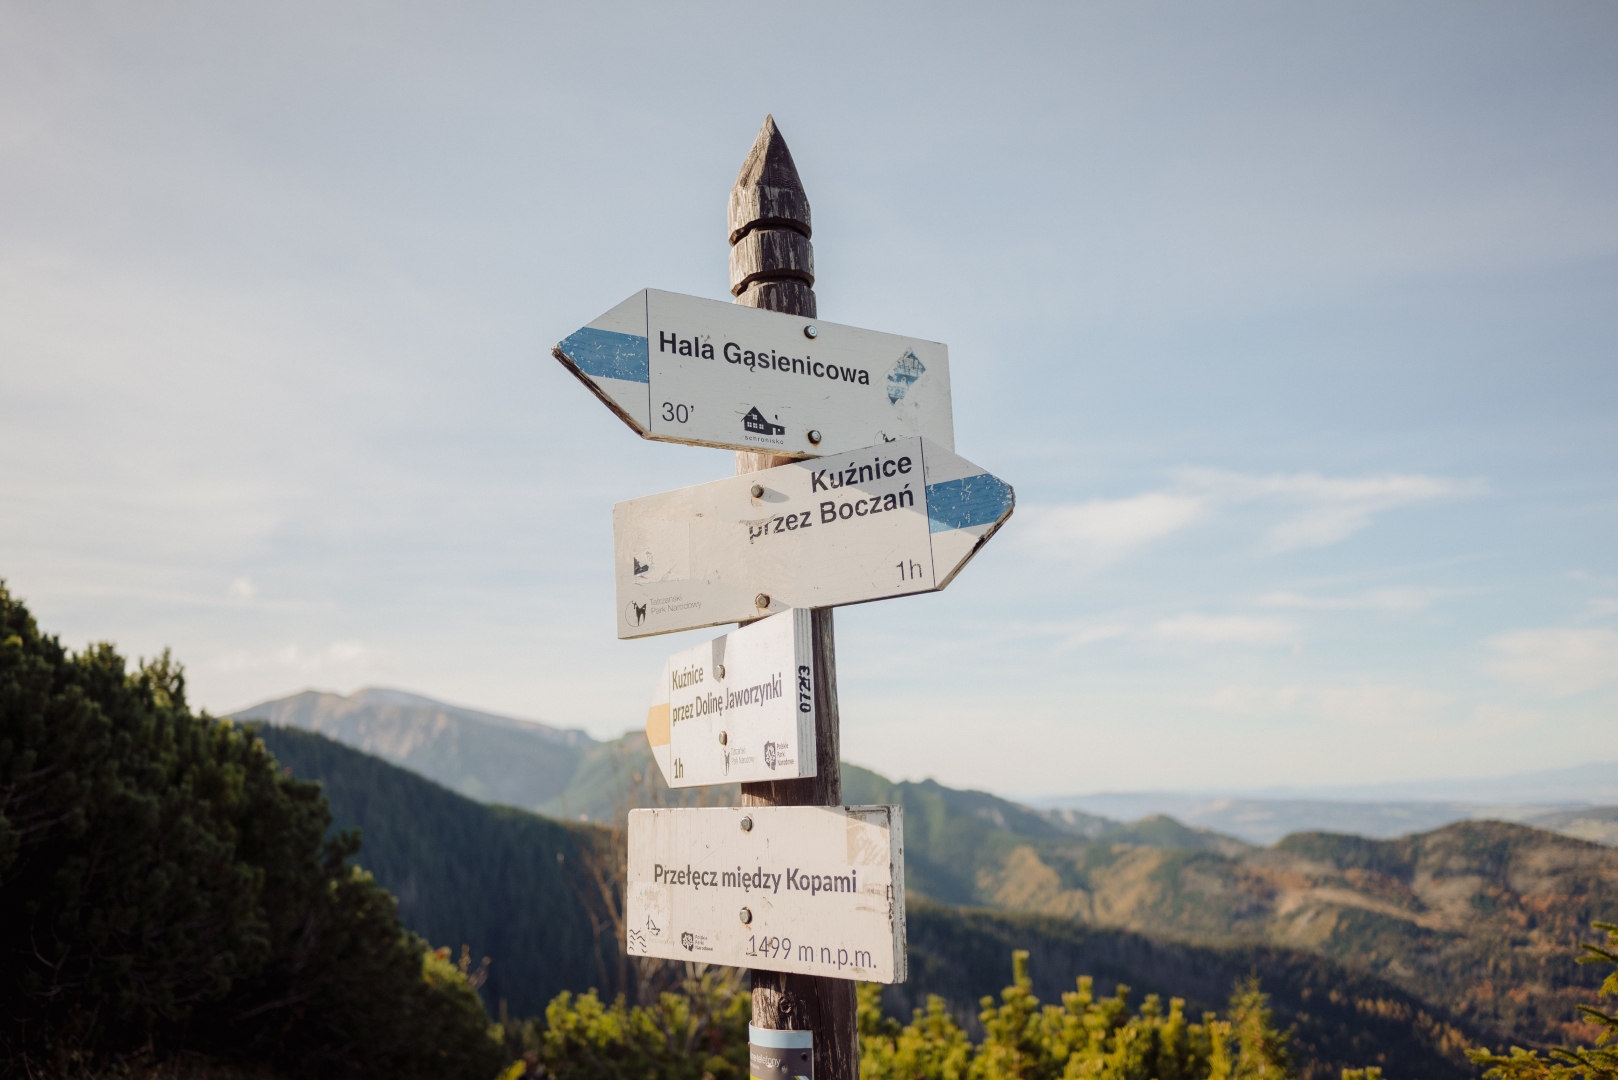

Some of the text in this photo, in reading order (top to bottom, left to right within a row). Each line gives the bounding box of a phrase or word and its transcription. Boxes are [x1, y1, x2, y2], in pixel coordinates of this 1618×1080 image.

[659, 330, 870, 386] Hala Gąsienicowa
[744, 435, 784, 445] schronisko
[811, 456, 912, 493] Kuźnice
[749, 483, 914, 544] przez Boczań
[650, 594, 682, 606] Tatrzański
[651, 601, 701, 614] Park Narodowy
[672, 664, 704, 691] Kuźnice
[672, 672, 782, 727] przez Dolinę Jaworzynki
[674, 757, 684, 779] 1h
[654, 863, 718, 891] Przełęcz
[722, 866, 782, 894] między
[786, 867, 857, 896] Kopami
[748, 934, 877, 970] 1499 m n.p.m.
